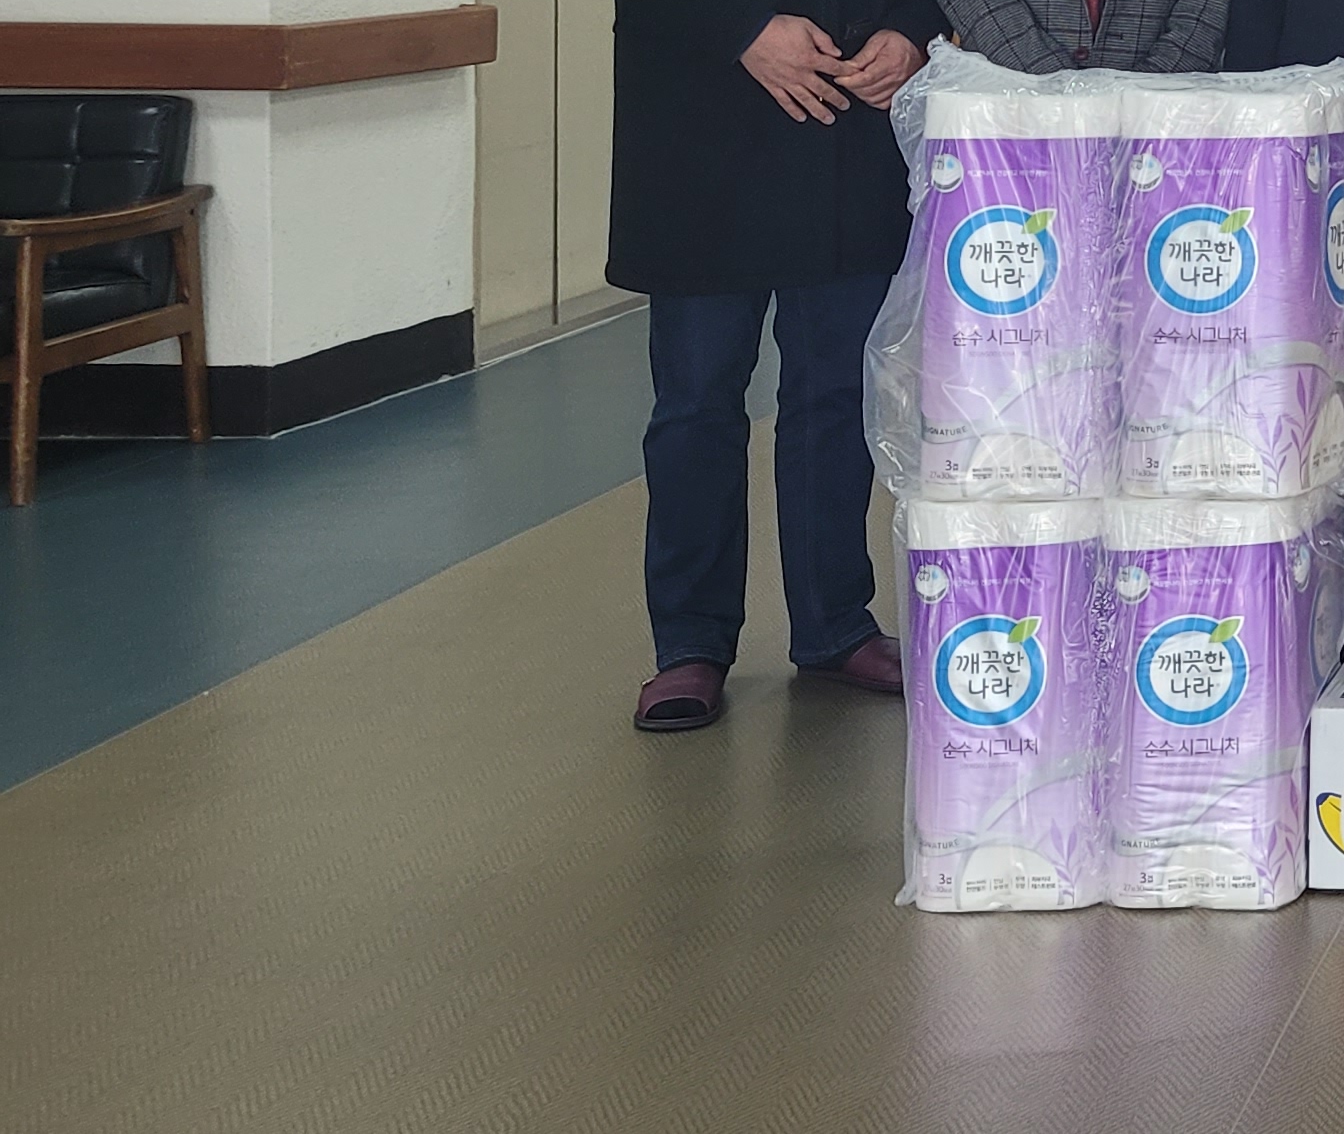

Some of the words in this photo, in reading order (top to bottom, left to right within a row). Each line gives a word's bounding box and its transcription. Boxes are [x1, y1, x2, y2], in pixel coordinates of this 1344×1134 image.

[968, 240, 1038, 264] 깨끗한
[1168, 240, 1235, 264] 깨끗한
[981, 267, 1025, 289] 나라
[1180, 266, 1223, 288] 나라
[952, 330, 983, 348] 순수
[987, 328, 1050, 347] 시그니처
[1152, 327, 1183, 345] 순수
[1187, 326, 1247, 345] 시그니처
[956, 650, 1024, 674] 깨끗한
[1158, 650, 1225, 673] 깨끗한
[968, 677, 1012, 699] 나라
[1170, 676, 1214, 698] 나라
[942, 741, 973, 759] 순수
[976, 738, 1039, 757] 시그니처
[1144, 740, 1173, 758] 순수
[1179, 737, 1239, 755] 시그니처
